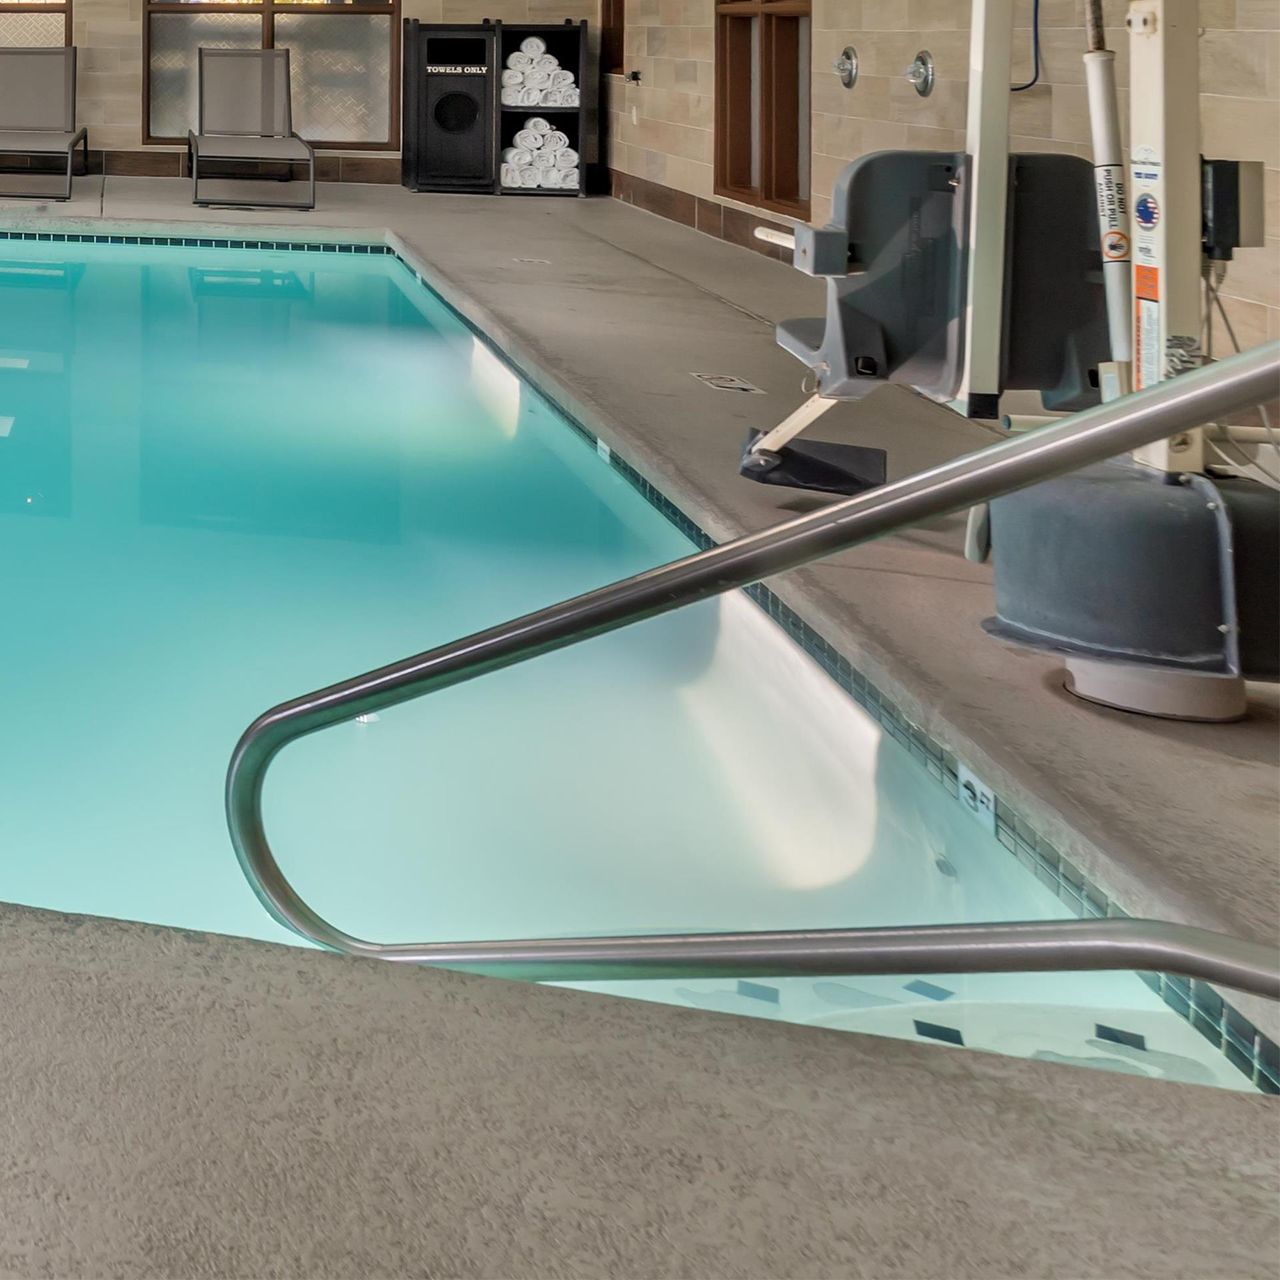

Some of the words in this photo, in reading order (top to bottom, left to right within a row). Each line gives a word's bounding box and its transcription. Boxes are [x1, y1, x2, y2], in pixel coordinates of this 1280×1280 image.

[426, 66, 463, 74] TOWELS
[464, 66, 488, 74] ONLY
[1104, 169, 1114, 192] PUSH
[1116, 182, 1124, 195] DO
[1097, 183, 1107, 217] AGAINST
[1106, 194, 1115, 206] OR
[1118, 197, 1127, 215] NOT
[1108, 208, 1118, 229] PULL
[963, 780, 979, 812] 3
